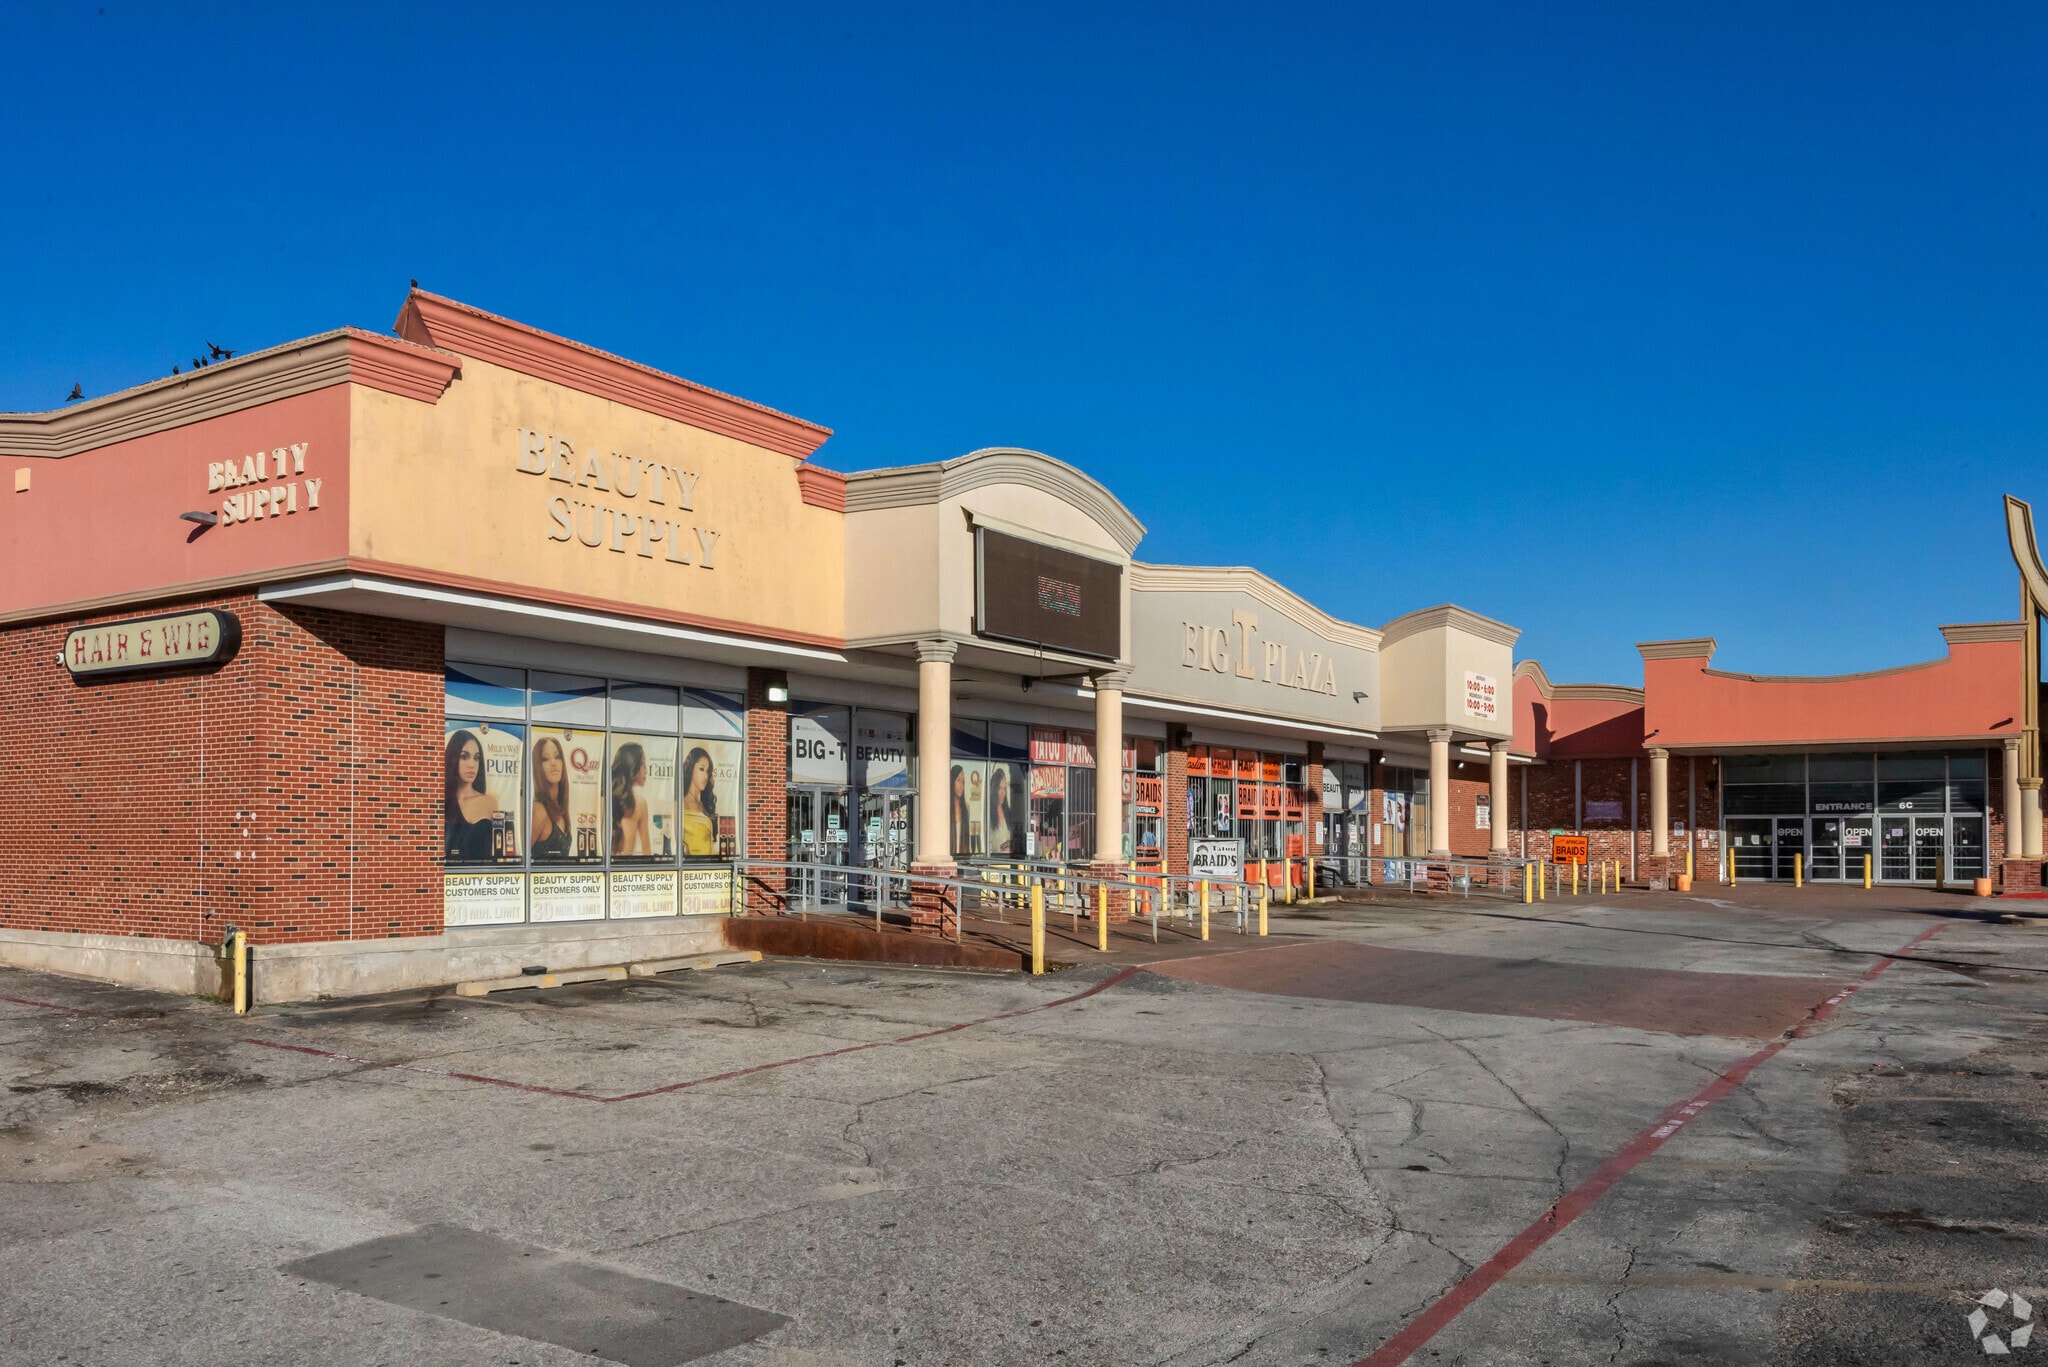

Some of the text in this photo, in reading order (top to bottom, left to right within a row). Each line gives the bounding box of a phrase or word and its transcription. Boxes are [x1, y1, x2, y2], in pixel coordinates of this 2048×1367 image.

[208, 442, 309, 494] BEAUTY
[516, 427, 699, 512] BEAUTY
[222, 477, 323, 527] SUPPLY
[548, 496, 720, 570] SUPPLY
[74, 621, 210, 665] HAIR & WIG
[1182, 608, 1338, 697] BIG T PLAZA
[1467, 680, 1480, 692] 10:00
[1484, 684, 1494, 695] 6:00
[1467, 698, 1480, 710] 10:00
[1484, 702, 1494, 714] 9:00
[857, 746, 904, 762] BEAUTY
[487, 759, 520, 774] PURE
[649, 762, 673, 778] rain
[714, 768, 737, 779] SAGA
[1137, 782, 1162, 803] BRAIDS
[1816, 802, 1873, 811] ENTRANCE
[1778, 828, 1803, 836] OPEN
[1845, 828, 1873, 837] OPEN
[1915, 828, 1944, 837] OPEN
[1556, 846, 1585, 856] BRAIDS
[1194, 854, 1237, 867] BRAID'S
[446, 876, 520, 886] BEAUTY SUPPLY
[534, 875, 600, 884] BEAUTY SUPPLY
[613, 873, 673, 882] BEAUTY SUPPLY
[446, 887, 520, 896] CUSTOMERS ONLY
[534, 886, 580, 894] CUSTOMERS
[613, 883, 673, 892] CUSTOMERS ONLY
